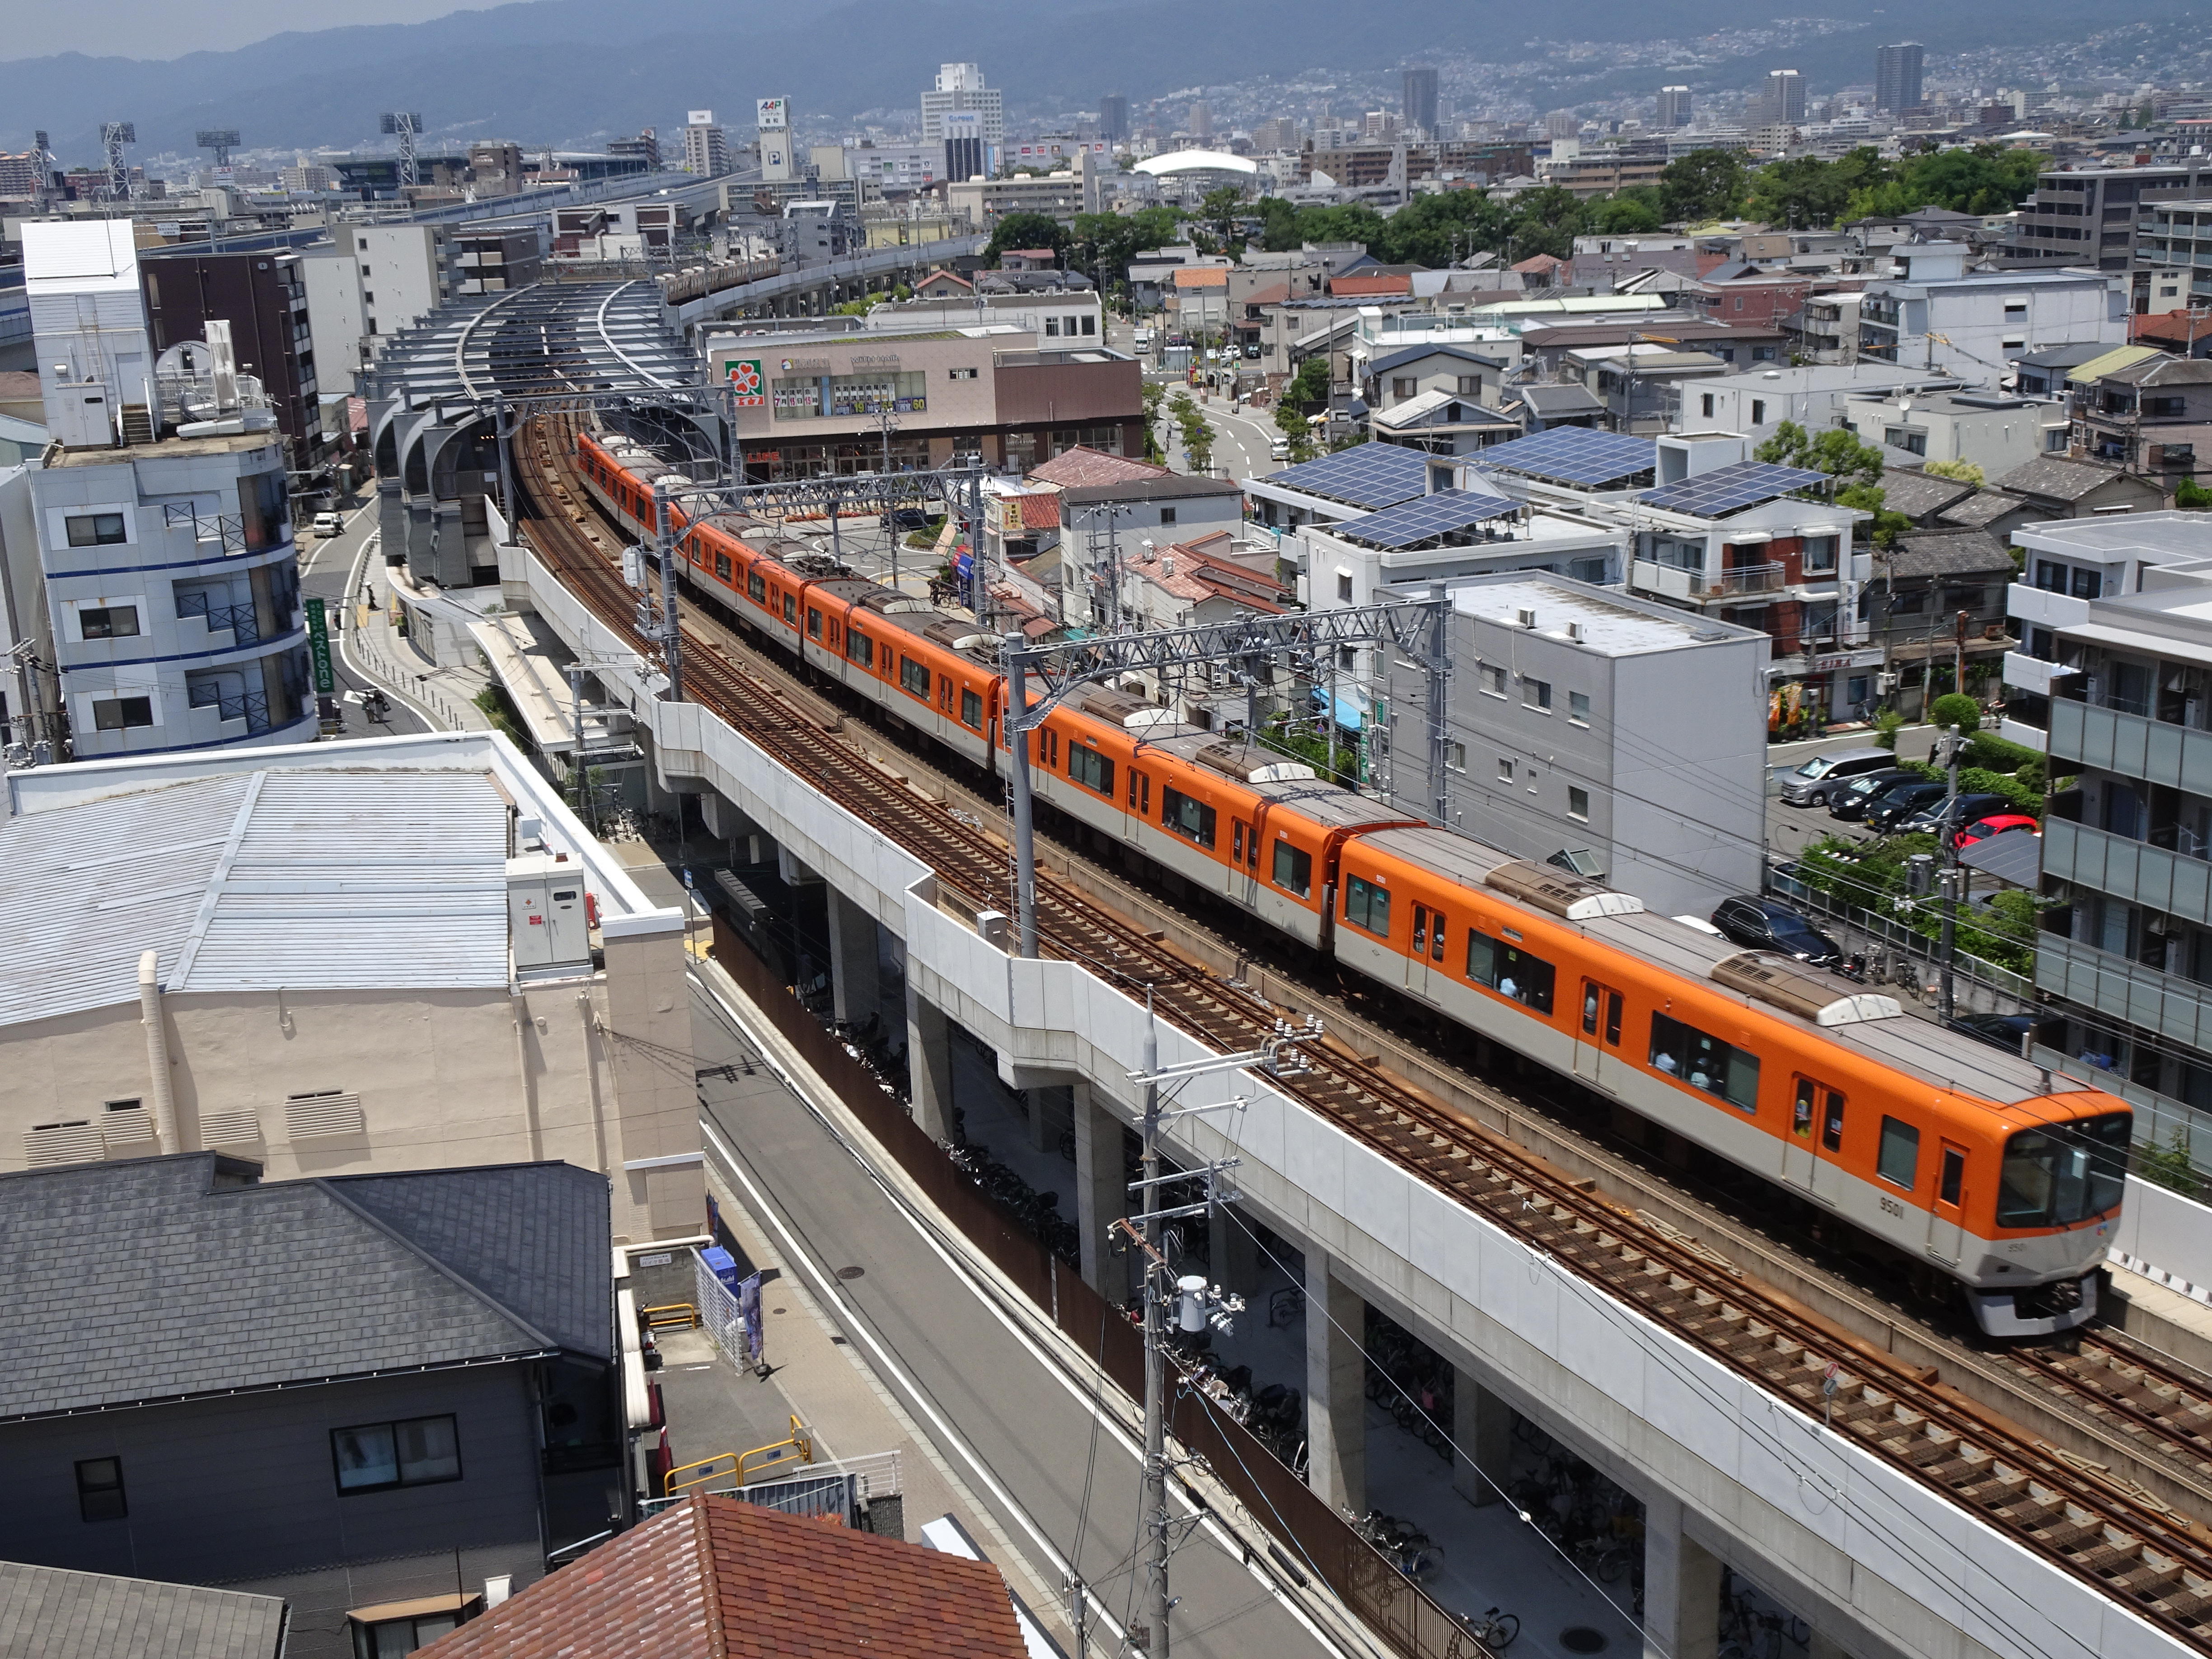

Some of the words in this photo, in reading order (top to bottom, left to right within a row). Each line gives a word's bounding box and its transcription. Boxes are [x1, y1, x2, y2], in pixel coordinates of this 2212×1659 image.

[760, 101, 781, 110] AAP
[913, 398, 925, 410] 60
[747, 452, 779, 463] LIFE
[314, 632, 330, 688] ベストone
[1880, 1197, 1904, 1219] 9501
